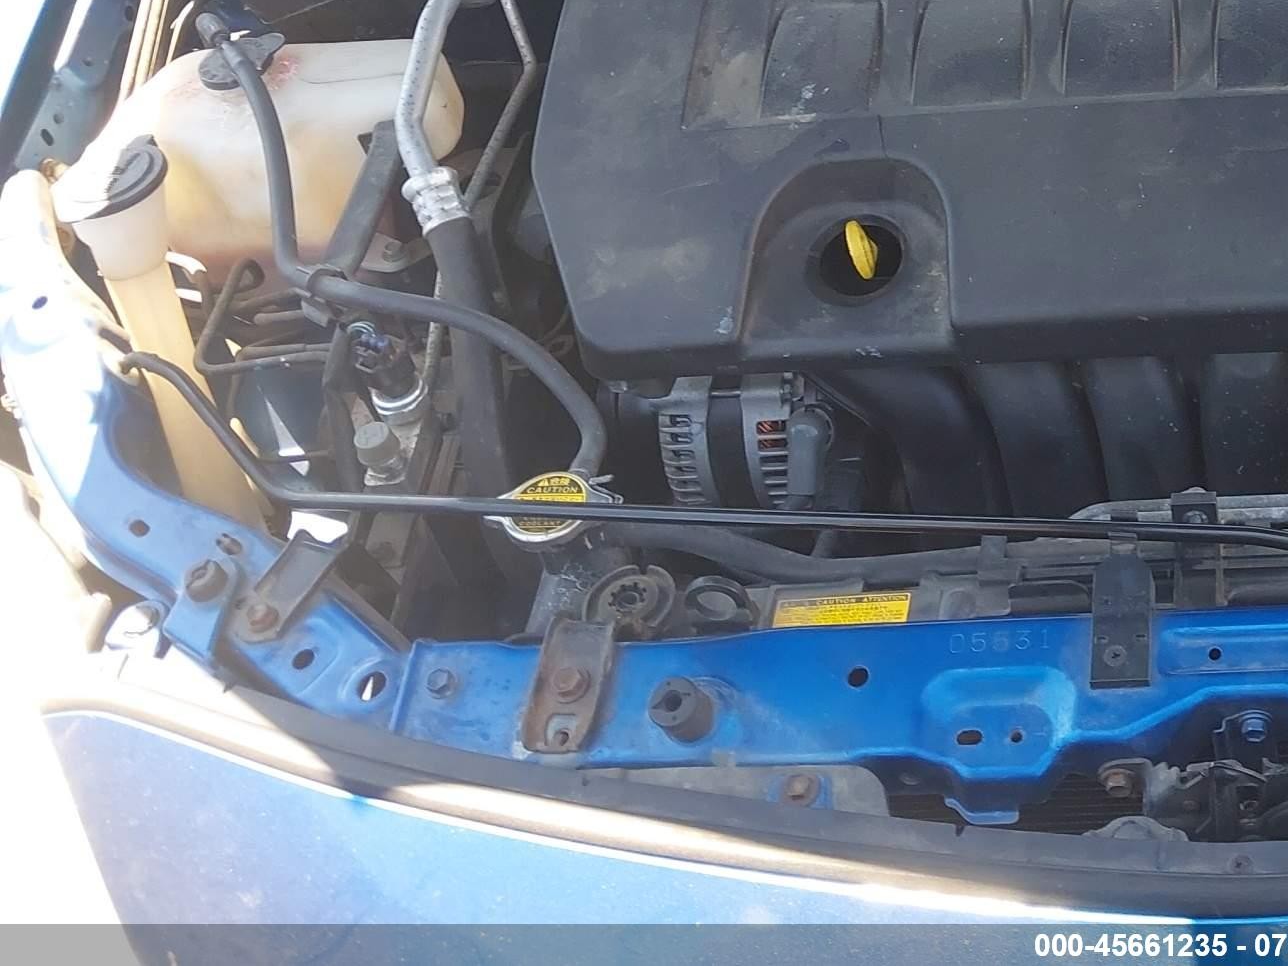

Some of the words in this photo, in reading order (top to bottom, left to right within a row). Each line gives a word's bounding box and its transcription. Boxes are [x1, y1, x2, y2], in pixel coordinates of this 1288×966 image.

[526, 486, 578, 494] CAUTION
[816, 597, 857, 606] CAUTION
[862, 595, 907, 603] ATTENTION
